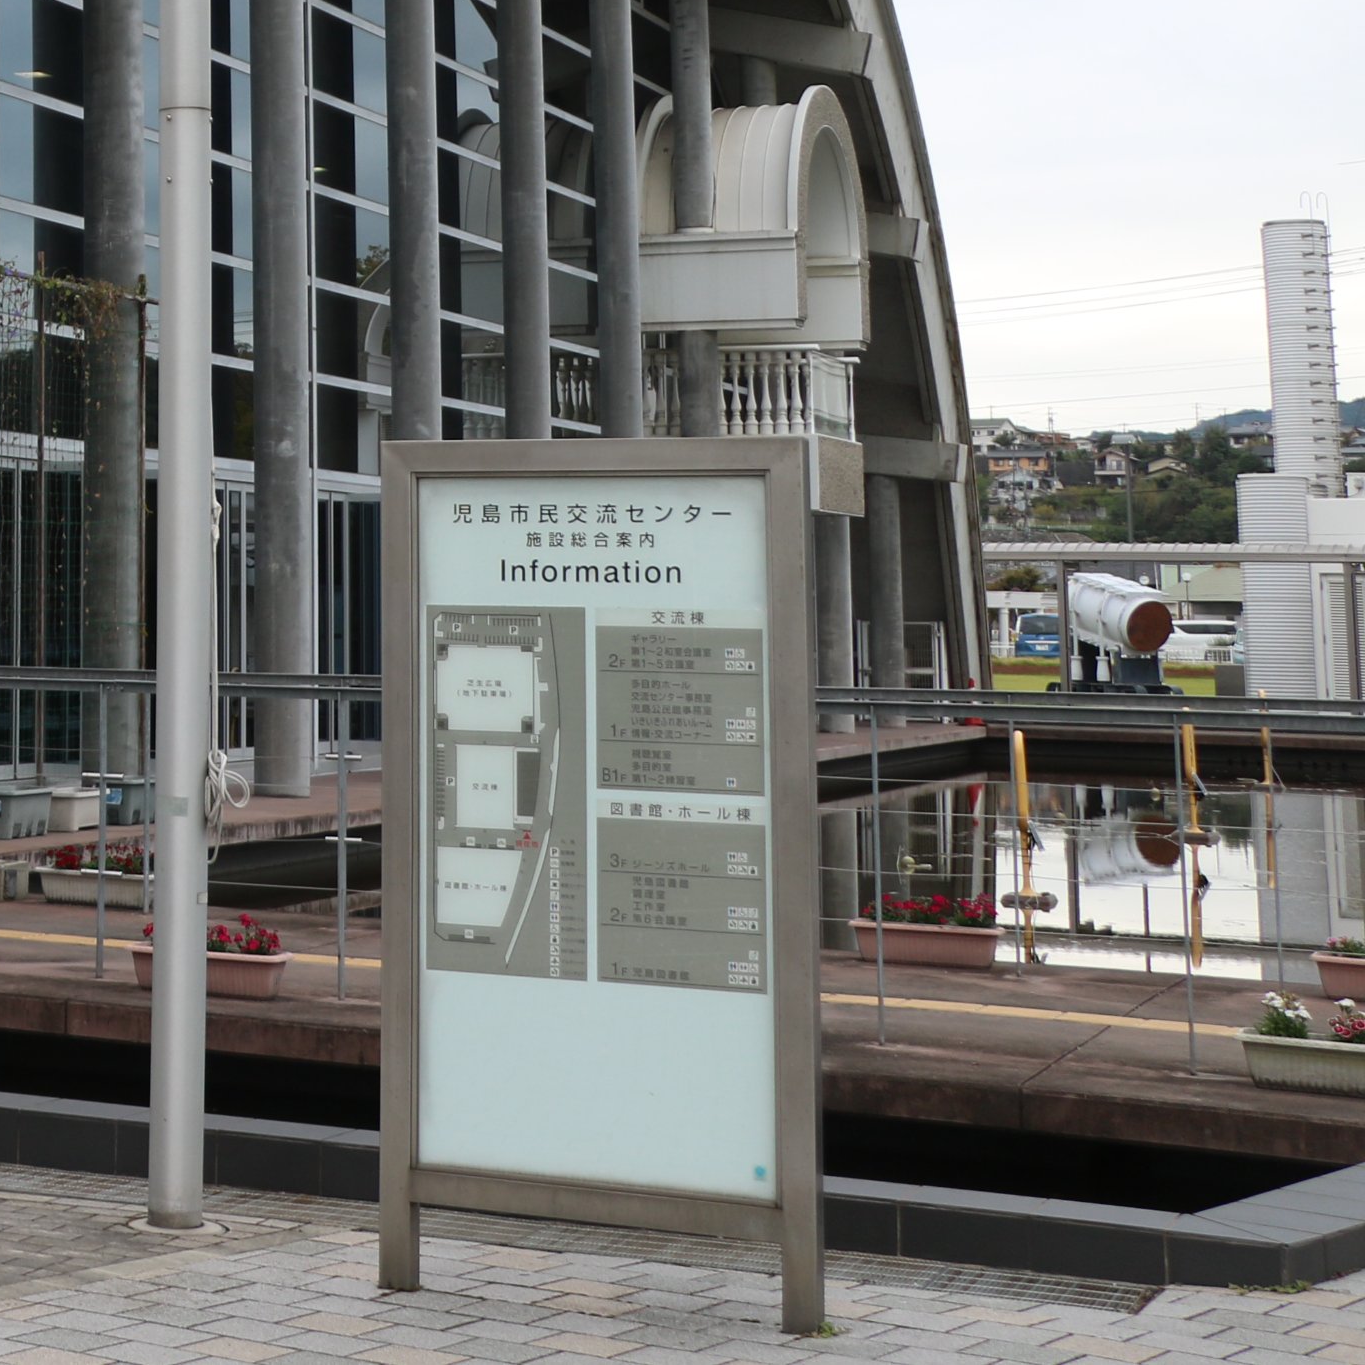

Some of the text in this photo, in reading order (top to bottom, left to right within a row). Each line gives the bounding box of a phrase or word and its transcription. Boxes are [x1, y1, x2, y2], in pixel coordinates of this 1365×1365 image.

[453, 503, 732, 525] 児島市民交流センター
[525, 531, 656, 549] 施設総合案内
[500, 559, 682, 584] Information
[651, 611, 705, 625] 交流棟
[454, 623, 461, 631] P
[510, 626, 517, 634] P
[631, 634, 677, 644] ギャラリー
[608, 653, 626, 668] 2F
[631, 679, 691, 690] 多目的ホール
[610, 723, 627, 738] 1F
[447, 777, 454, 785] P
[602, 767, 626, 783] B1F
[610, 801, 752, 822] 図書館・ホール棟
[609, 852, 627, 869] 3F
[609, 907, 627, 922] 2F
[632, 901, 666, 913] 工作室
[611, 961, 628, 977] 1F
